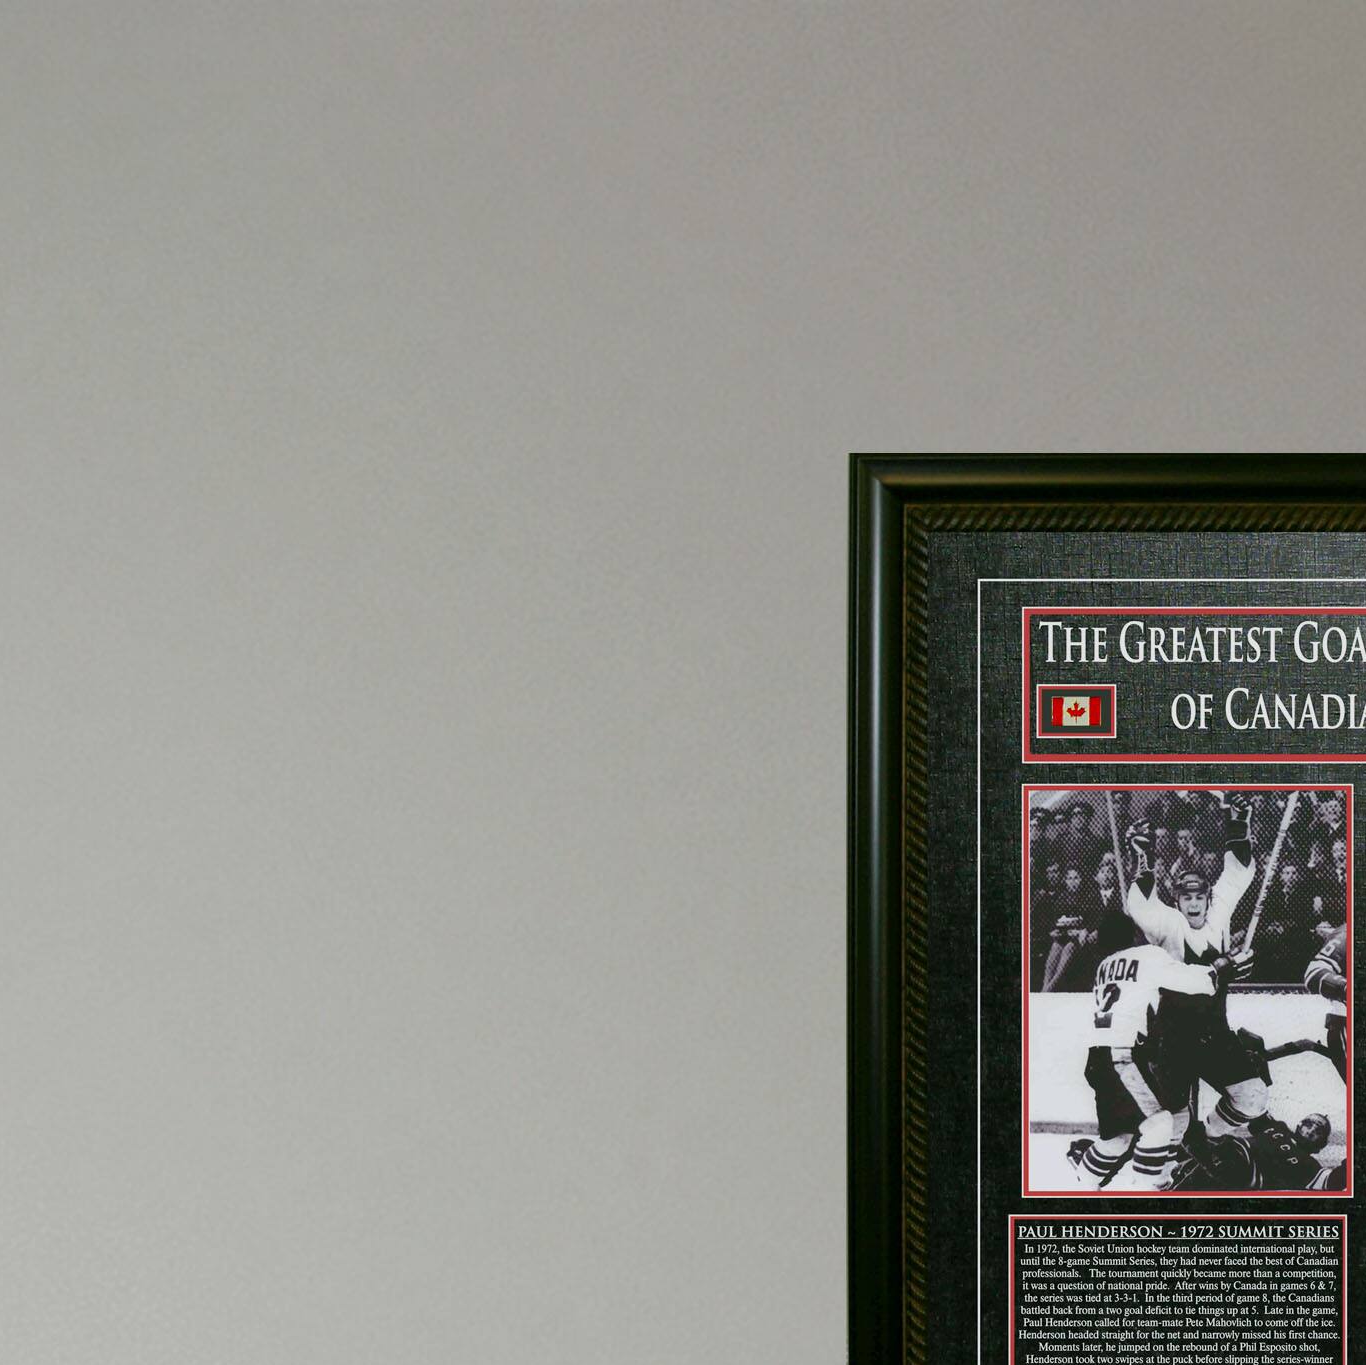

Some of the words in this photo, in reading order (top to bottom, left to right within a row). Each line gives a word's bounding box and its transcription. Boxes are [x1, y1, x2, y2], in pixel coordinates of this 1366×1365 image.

[1019, 1226, 1057, 1237] PAUL
[1062, 1226, 1163, 1237] HENDERSON
[1181, 1225, 1213, 1237] 1972
[1218, 1225, 1284, 1237] SUMMIT
[1288, 1225, 1339, 1237] SERIES
[1025, 1244, 1034, 1253] In
[1038, 1244, 1059, 1255] 1972,
[1063, 1244, 1075, 1253] the
[1078, 1244, 1105, 1253] Soviet
[1107, 1244, 1134, 1253] Union
[1137, 1244, 1166, 1256] hockey
[1192, 1244, 1238, 1253] dominated
[1241, 1244, 1295, 1253] international
[1298, 1244, 1317, 1256] play,
[1320, 1244, 1334, 1253] but
[1023, 1269, 1081, 1280] professionals.
[1089, 1269, 1106, 1278] The
[1109, 1270, 1159, 1278] tournament
[1161, 1269, 1191, 1280] quickly
[1194, 1269, 1226, 1278] became
[1253, 1269, 1273, 1278] than
[1283, 1269, 1336, 1280] competition,
[1024, 1318, 1043, 1327] Paul
[1045, 1318, 1092, 1327] Henderson
[1095, 1318, 1120, 1327] called
[1123, 1318, 1135, 1327] for
[1137, 1319, 1183, 1327] team-mate
[1186, 1318, 1203, 1327] Pete
[1206, 1318, 1252, 1327] Mahovlich
[1255, 1319, 1263, 1327] to
[1291, 1318, 1304, 1327] off
[1306, 1318, 1319, 1327] the
[1321, 1318, 1335, 1327] ice.
[1026, 1355, 1073, 1364] Henderson
[1076, 1355, 1095, 1364] took
[1097, 1356, 1113, 1364] two
[1115, 1355, 1143, 1365] swipes
[1146, 1356, 1155, 1364] at
[1157, 1355, 1170, 1364] the
[1173, 1355, 1193, 1365] puck
[1195, 1355, 1223, 1364] before
[1225, 1355, 1259, 1365] slipping
[1261, 1355, 1275, 1364] the
[1277, 1355, 1333, 1364] series-winner
